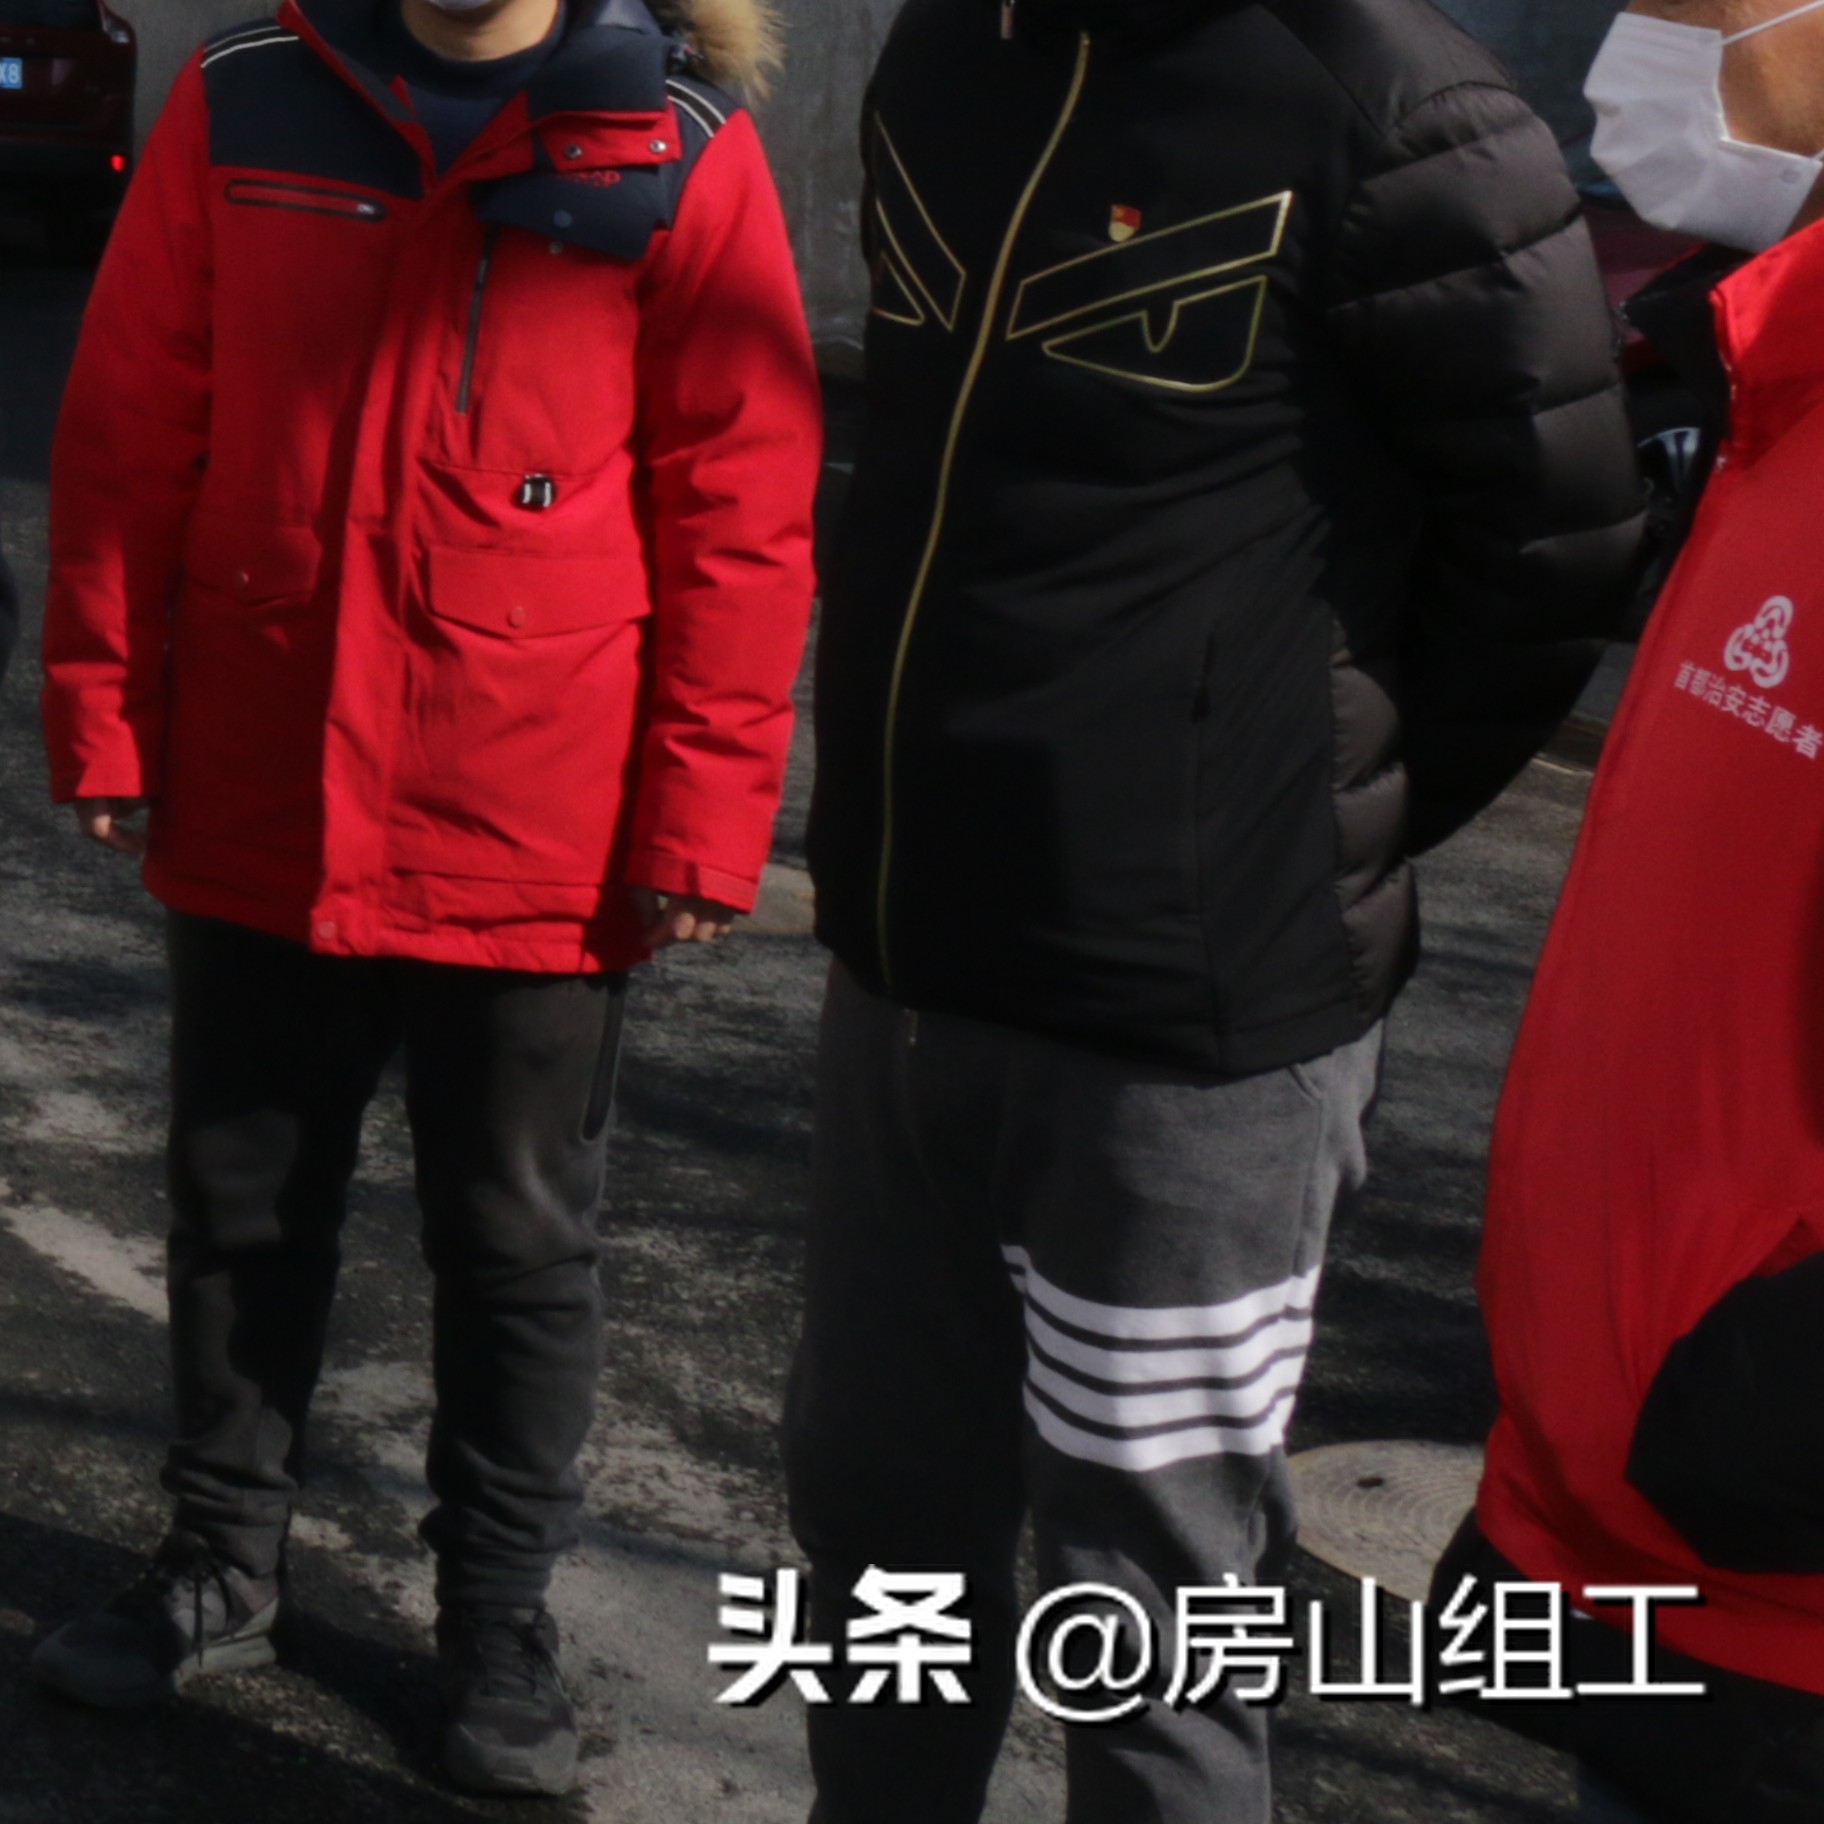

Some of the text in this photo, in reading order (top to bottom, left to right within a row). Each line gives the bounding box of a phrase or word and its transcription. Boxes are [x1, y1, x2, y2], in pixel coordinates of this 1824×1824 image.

[1674, 659, 1823, 760] 首都治安志愿者
